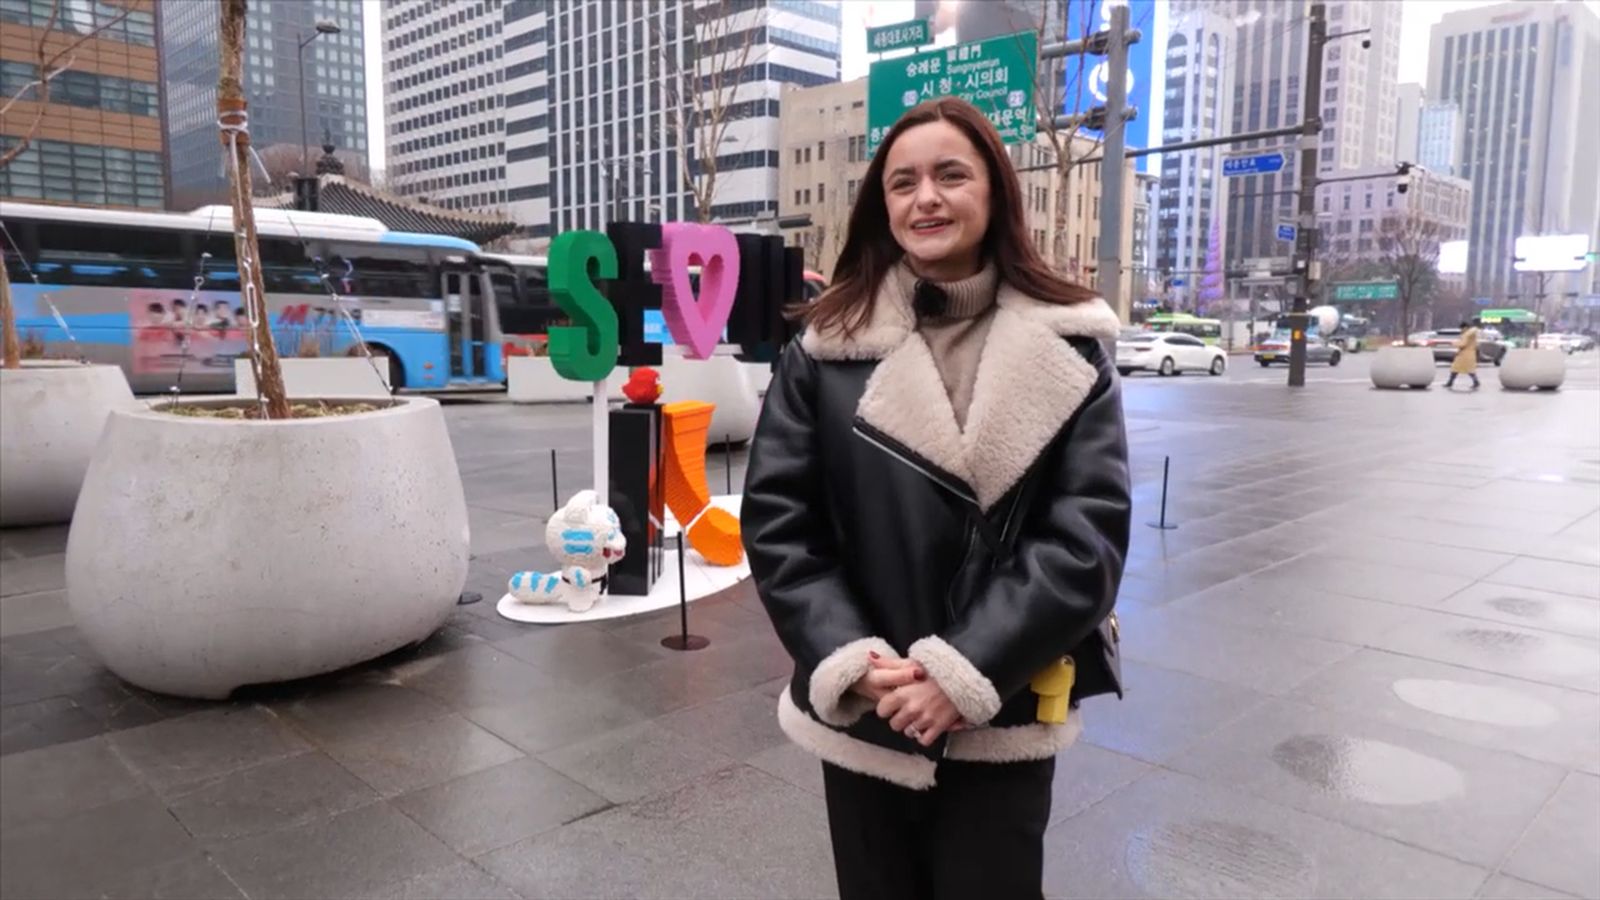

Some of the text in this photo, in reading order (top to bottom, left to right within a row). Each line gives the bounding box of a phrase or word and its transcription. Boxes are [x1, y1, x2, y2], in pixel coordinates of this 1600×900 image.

[874, 24, 924, 48] 세종대로사거리
[906, 57, 941, 77] 숭례문
[975, 86, 1008, 99] Council
